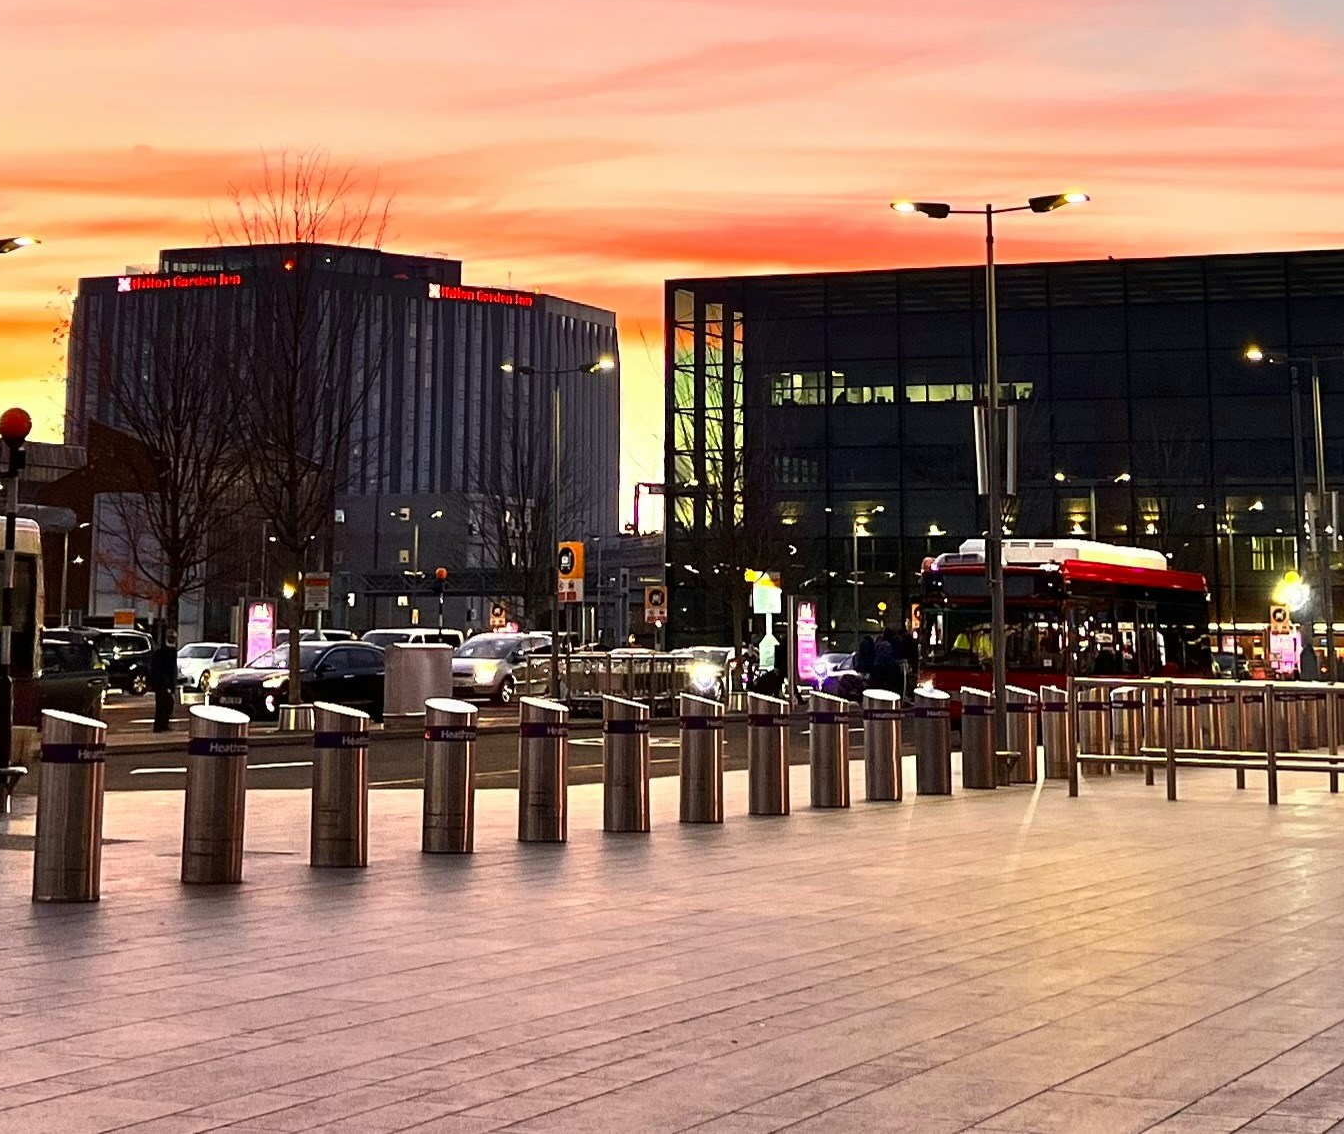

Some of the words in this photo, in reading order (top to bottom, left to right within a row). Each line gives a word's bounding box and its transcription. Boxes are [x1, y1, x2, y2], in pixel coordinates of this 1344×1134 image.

[132, 277, 171, 290] Hilton
[173, 275, 217, 287] Garden
[219, 273, 241, 285] Inn
[441, 285, 475, 300] Hilton
[476, 289, 513, 304] Garden
[515, 293, 533, 306] Inn
